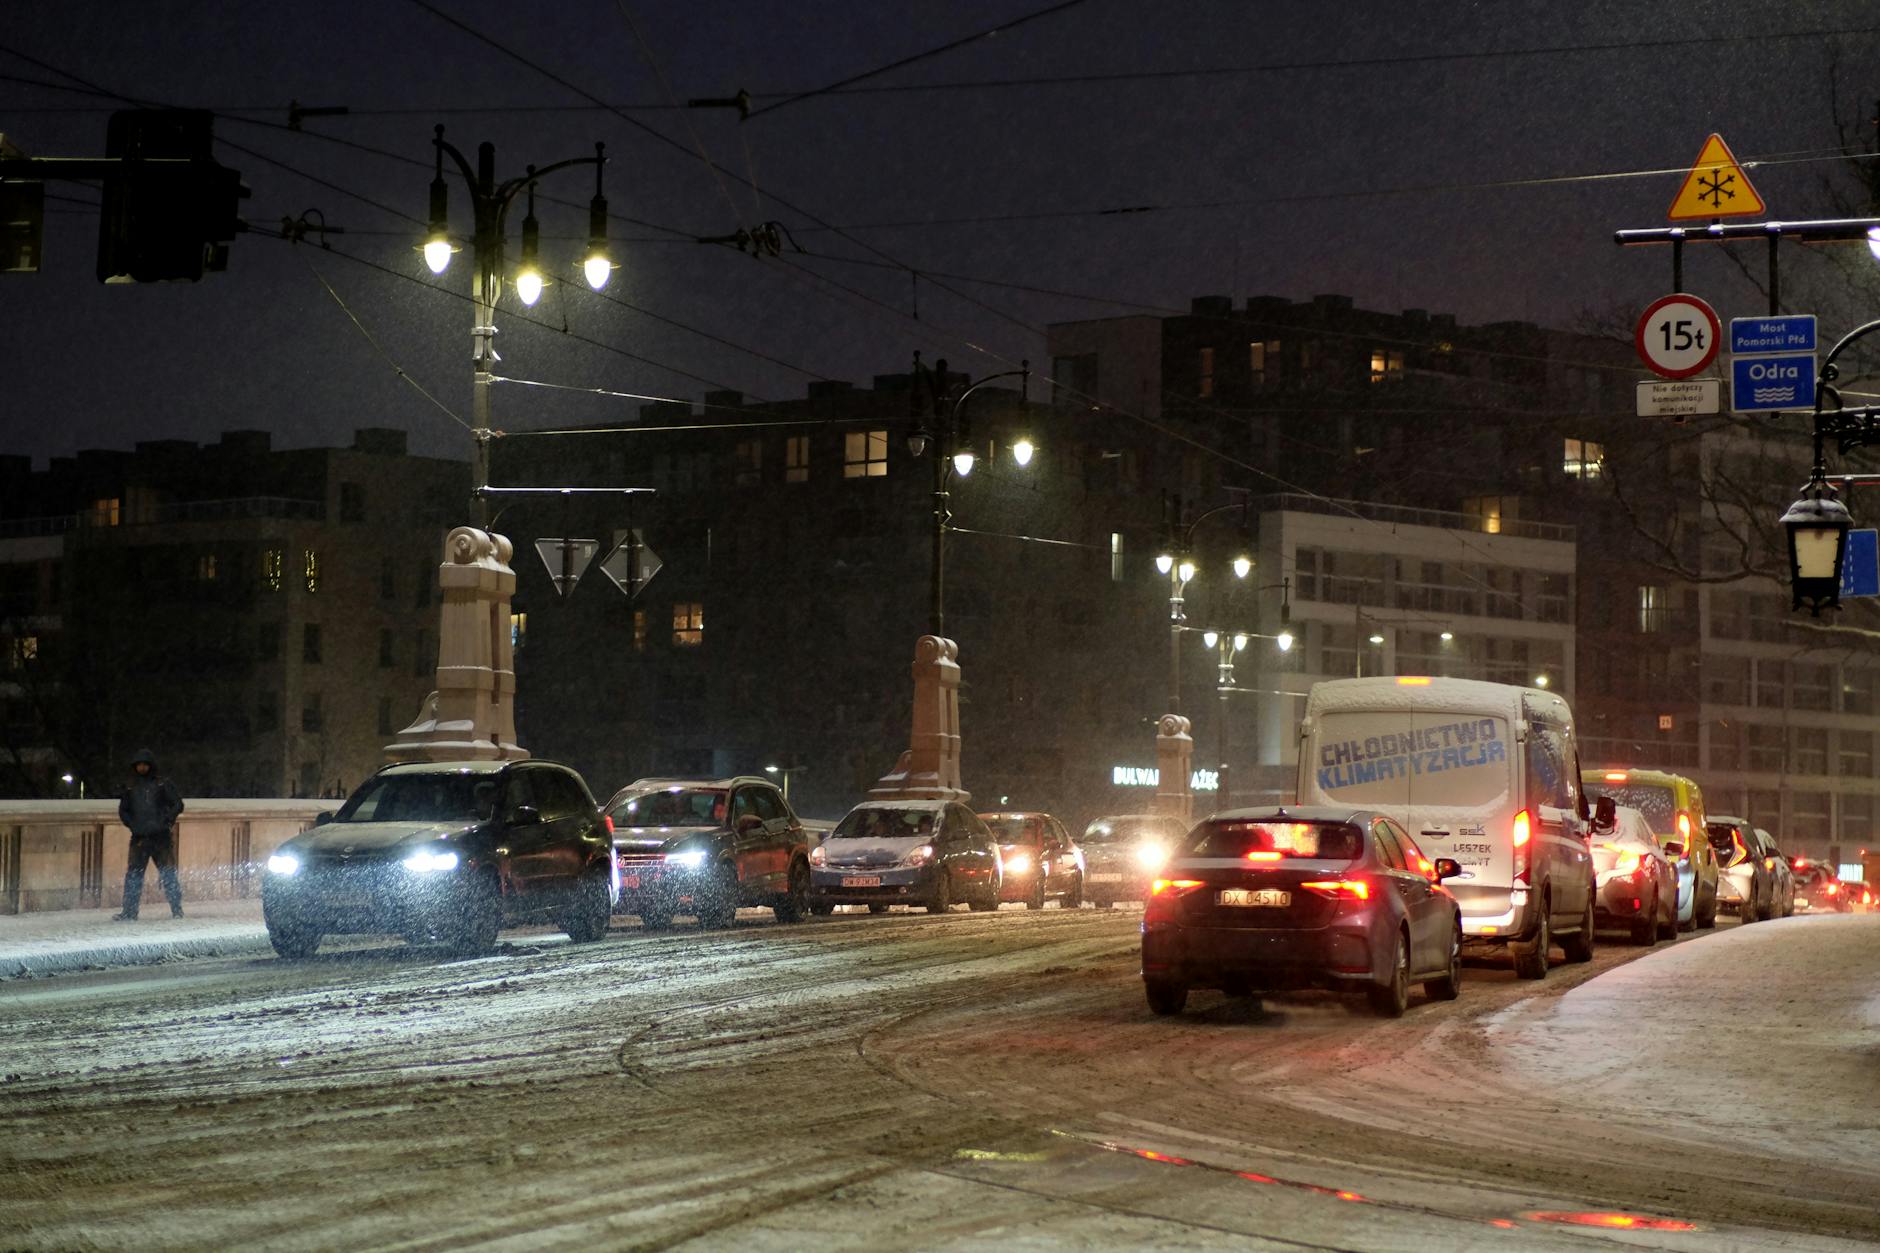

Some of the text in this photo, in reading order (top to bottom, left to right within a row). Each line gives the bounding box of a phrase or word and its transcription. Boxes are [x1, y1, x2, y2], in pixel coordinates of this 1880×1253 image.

[1660, 320, 1704, 351] 15t
[1760, 323, 1786, 333] Most
[1737, 336, 1784, 347] Pomorski
[1749, 363, 1798, 380] Odra
[1652, 384, 1667, 392] Nie
[1321, 719, 1496, 766] CHŁODNICTWO
[1318, 741, 1505, 790] KLIMATYZACJA
[1223, 891, 1288, 905] DX 04510
